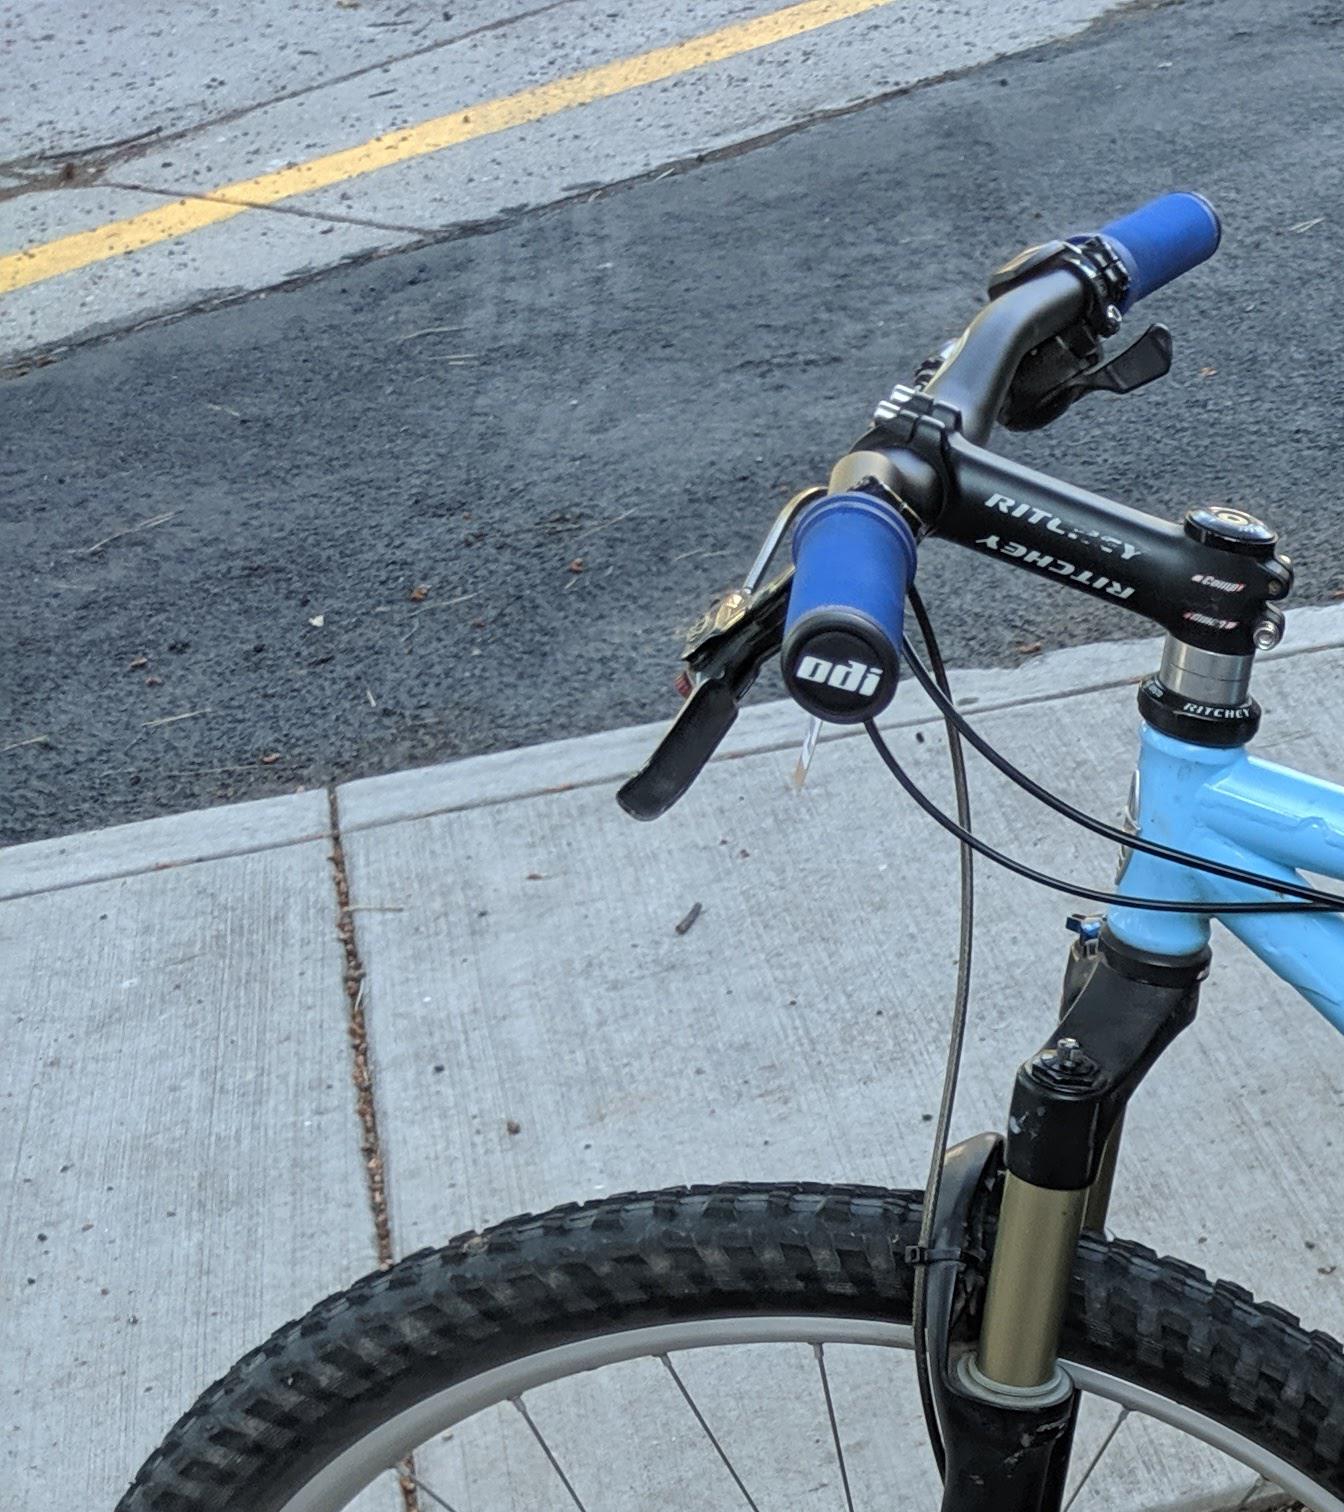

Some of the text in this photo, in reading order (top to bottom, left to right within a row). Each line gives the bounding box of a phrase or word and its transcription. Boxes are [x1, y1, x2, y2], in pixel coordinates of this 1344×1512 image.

[984, 493, 1142, 561] RITCEY
[975, 534, 1136, 600] RITCHEY
[795, 655, 883, 697] odi
[1183, 702, 1251, 719] RITCHEY
